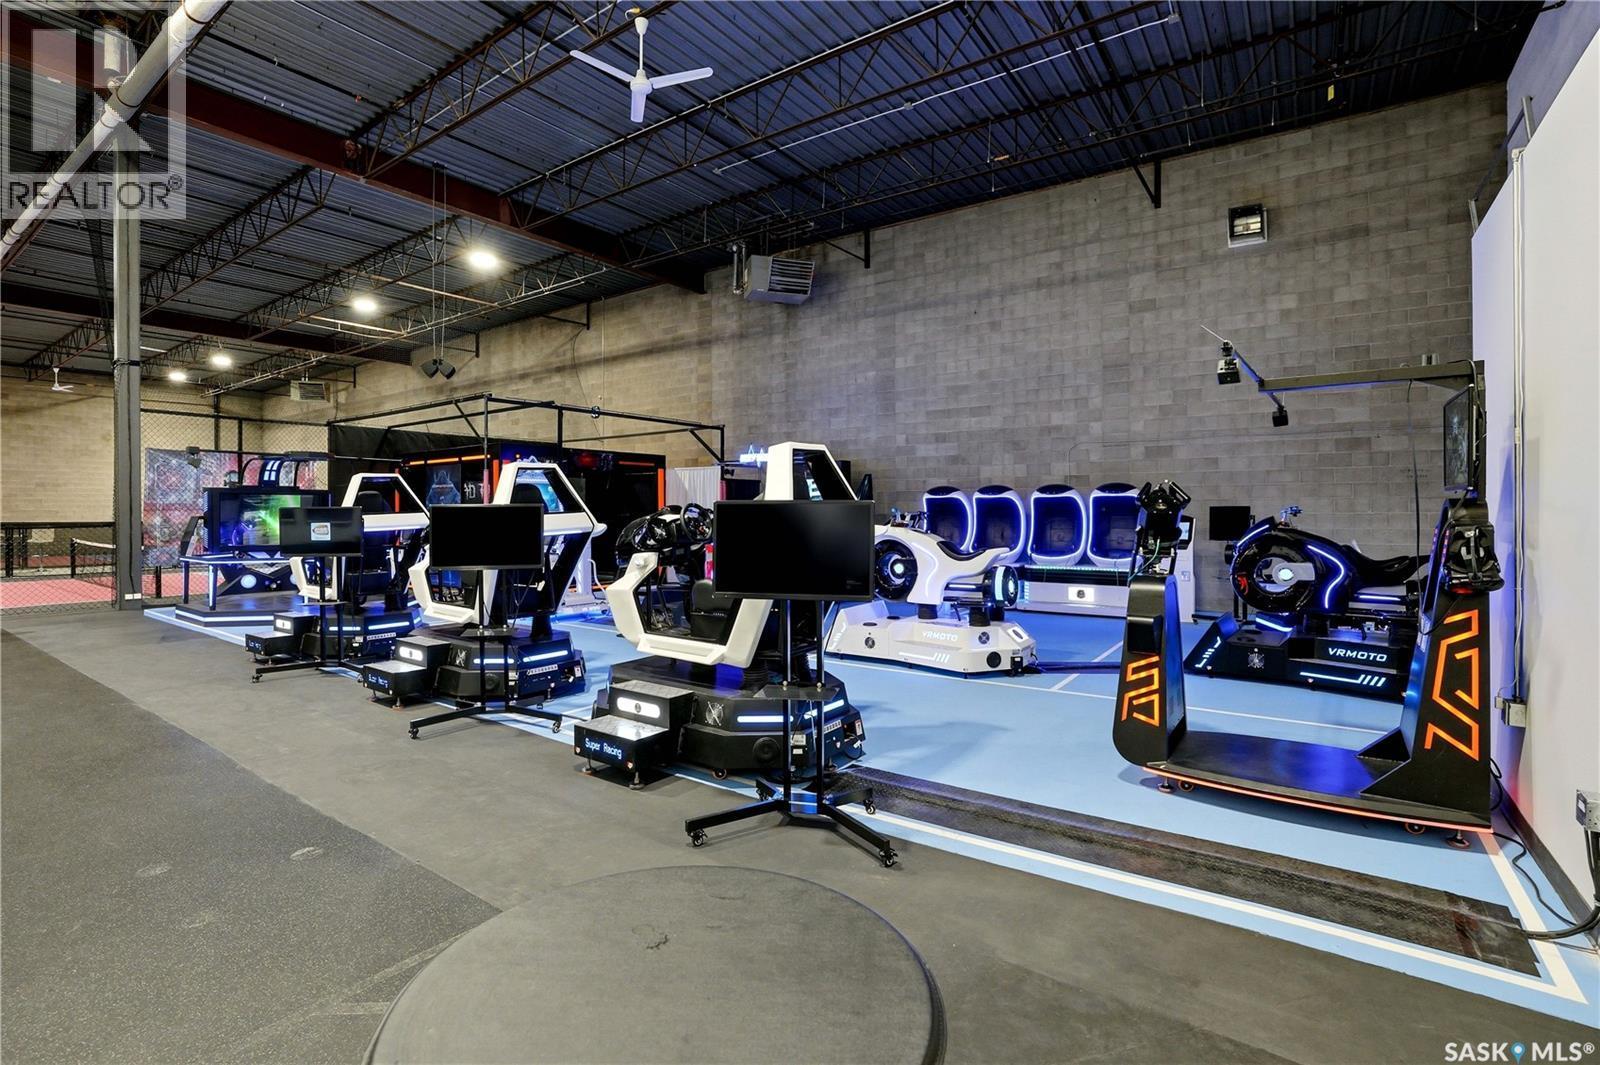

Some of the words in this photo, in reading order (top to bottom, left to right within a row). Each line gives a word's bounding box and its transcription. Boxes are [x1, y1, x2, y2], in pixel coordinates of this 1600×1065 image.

[1328, 647, 1387, 662] VRMOTO
[584, 737, 600, 751] Super
[603, 742, 622, 760] Racing
